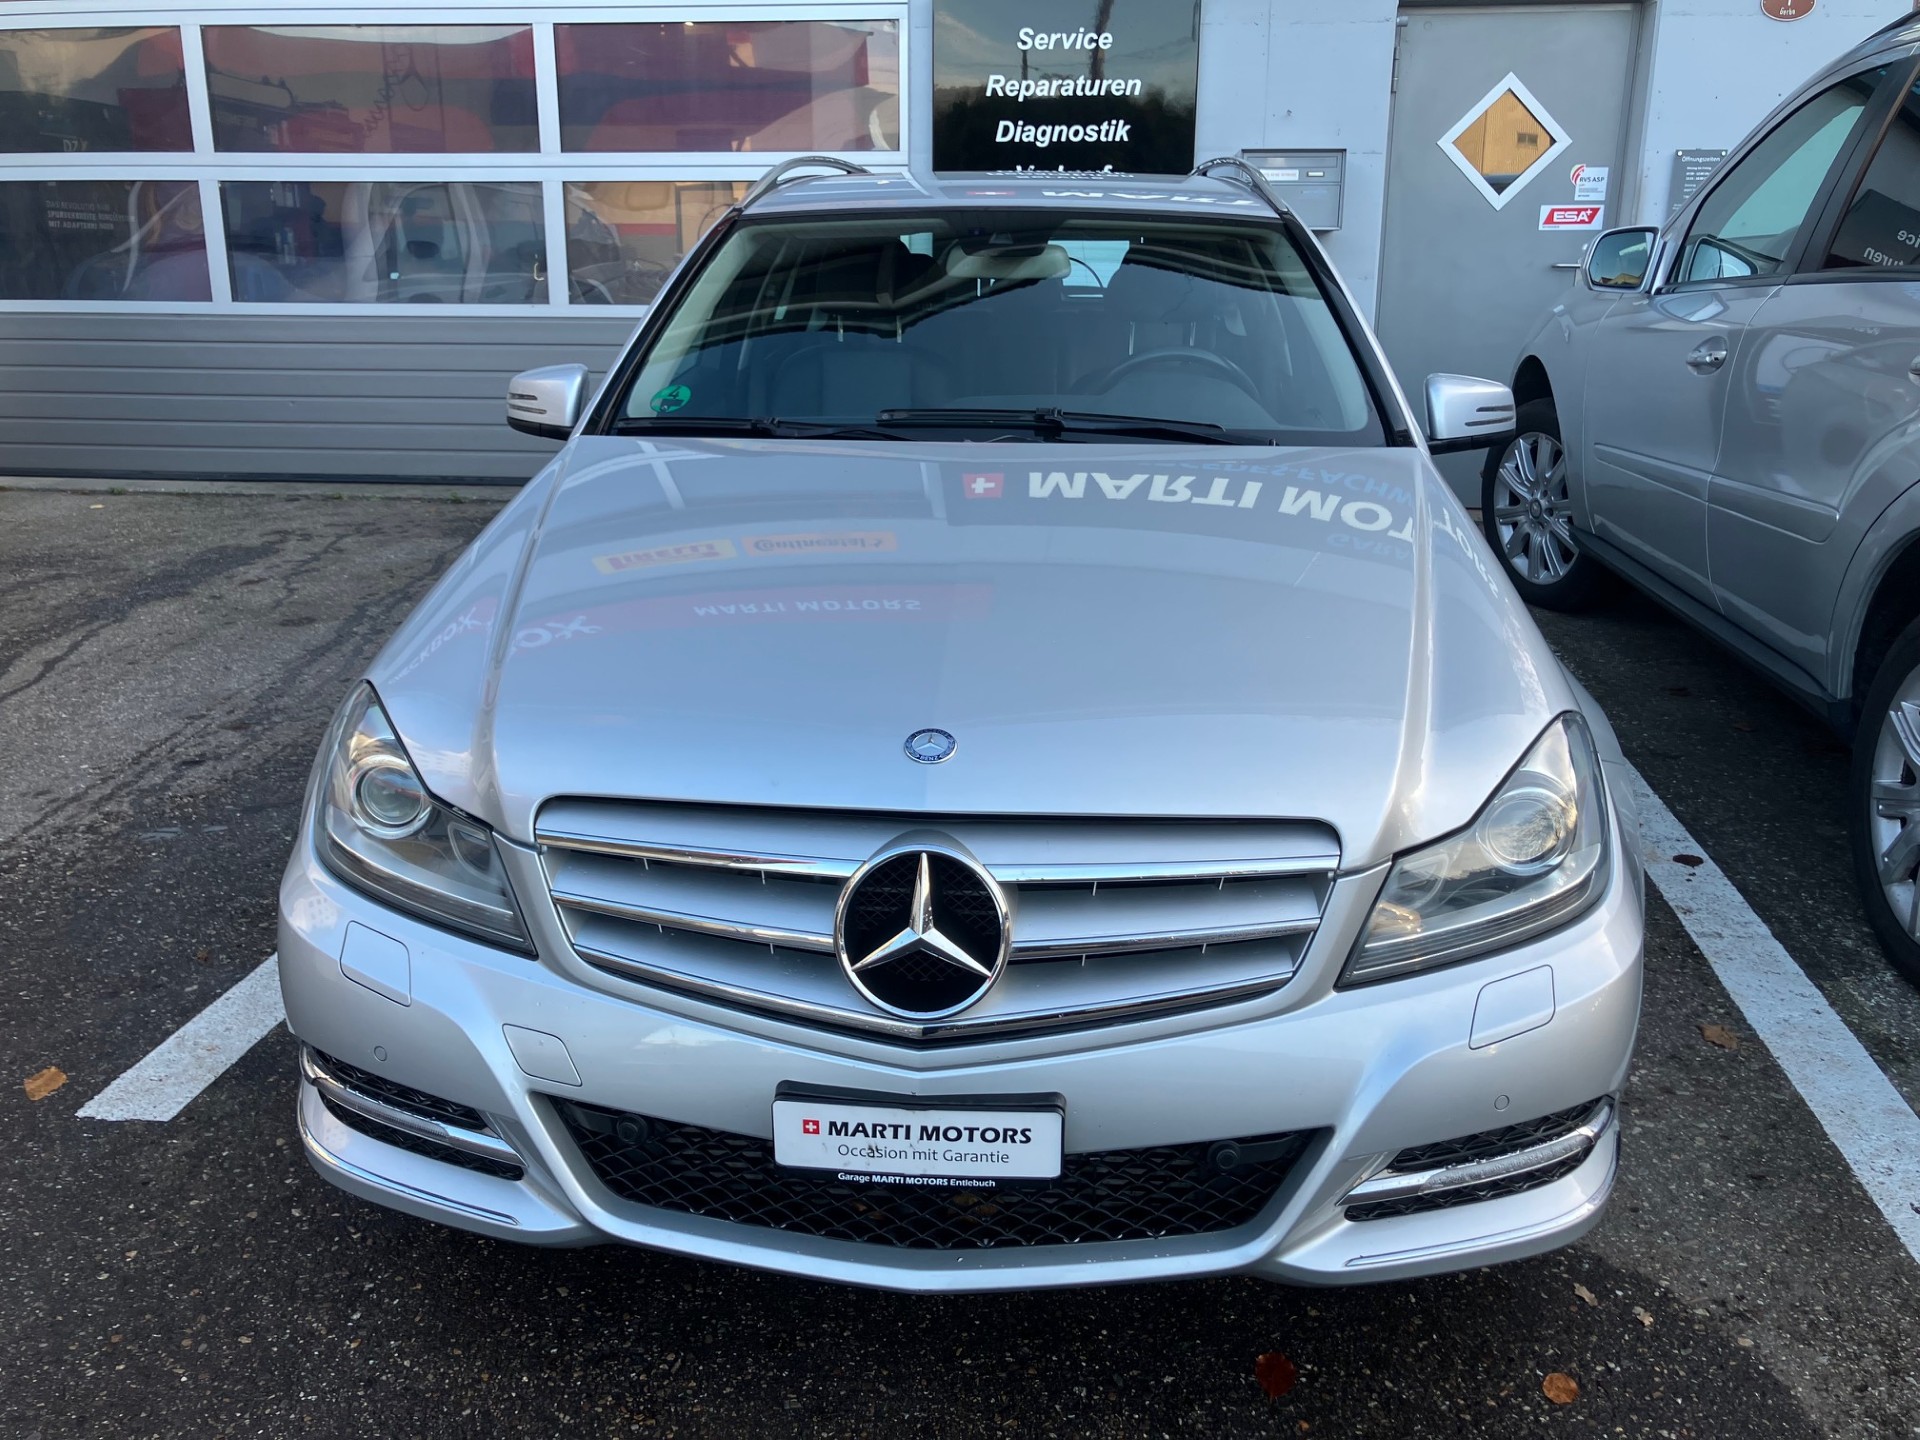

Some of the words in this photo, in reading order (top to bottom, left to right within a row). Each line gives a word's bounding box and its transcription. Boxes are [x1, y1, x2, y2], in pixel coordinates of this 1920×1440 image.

[1016, 27, 1113, 50] Service
[985, 74, 1142, 102] Reparaturen
[995, 119, 1131, 147] Diagnostik
[828, 1120, 912, 1141] MARTI
[919, 1125, 1032, 1144] MOTORS
[838, 1144, 908, 1160] Occasion
[913, 1149, 938, 1162] mit
[943, 1149, 1010, 1164] Garantie
[838, 1172, 870, 1183] Garage
[872, 1175, 904, 1185] MARTI
[905, 1176, 948, 1186] MOTORS
[950, 1178, 996, 1188] Entlebuch
